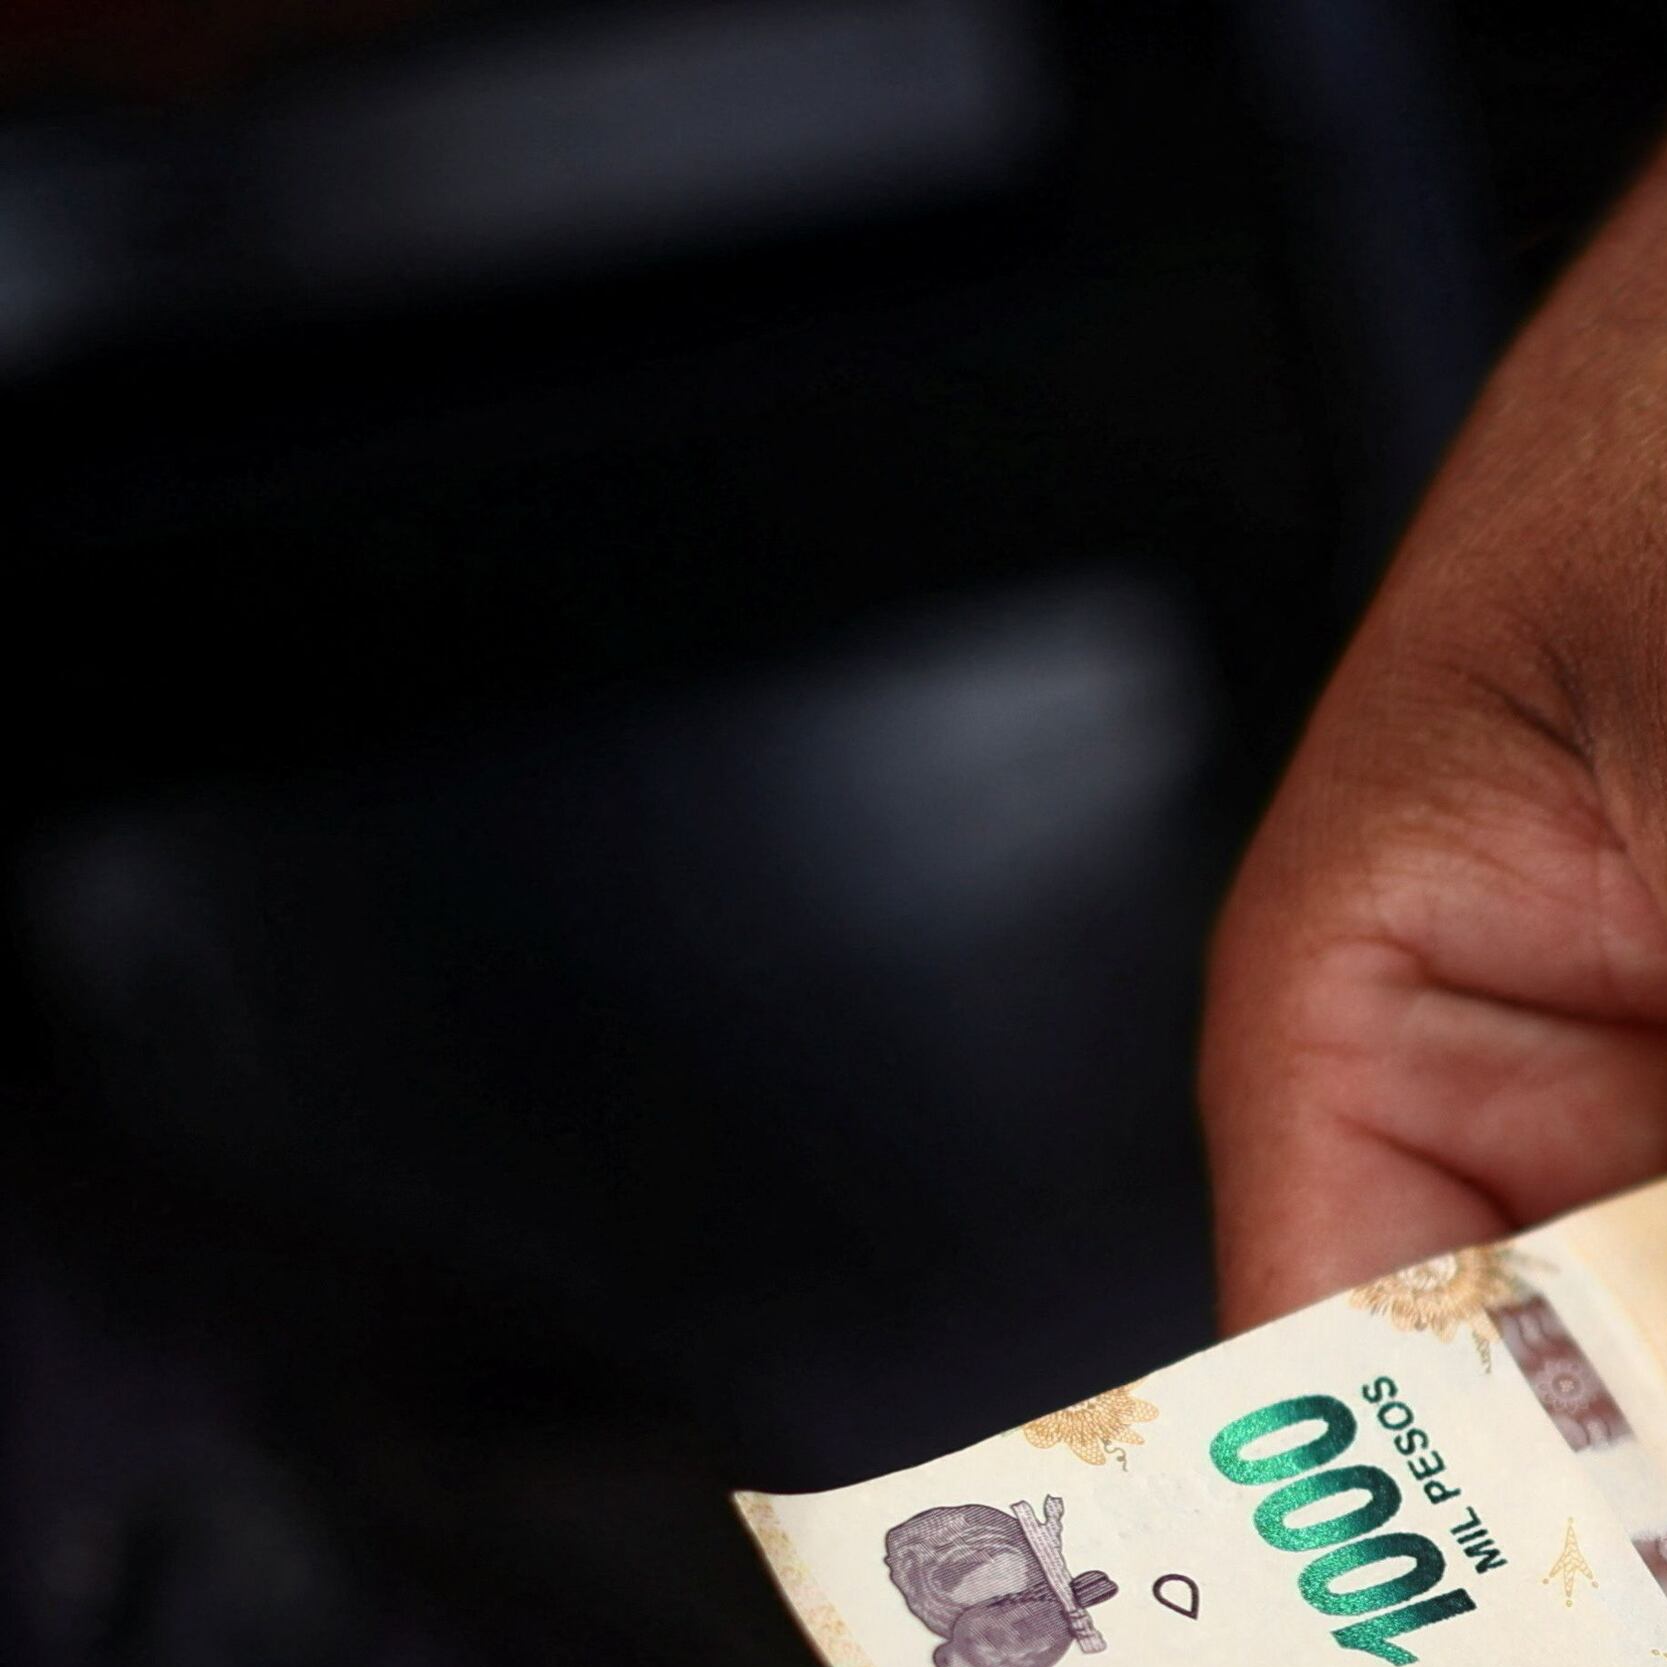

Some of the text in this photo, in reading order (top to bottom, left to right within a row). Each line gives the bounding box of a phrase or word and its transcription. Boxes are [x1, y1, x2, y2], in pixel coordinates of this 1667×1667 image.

[1209, 1394, 1477, 1667] 1000
[1361, 1375, 1508, 1574] MIL PESOS
